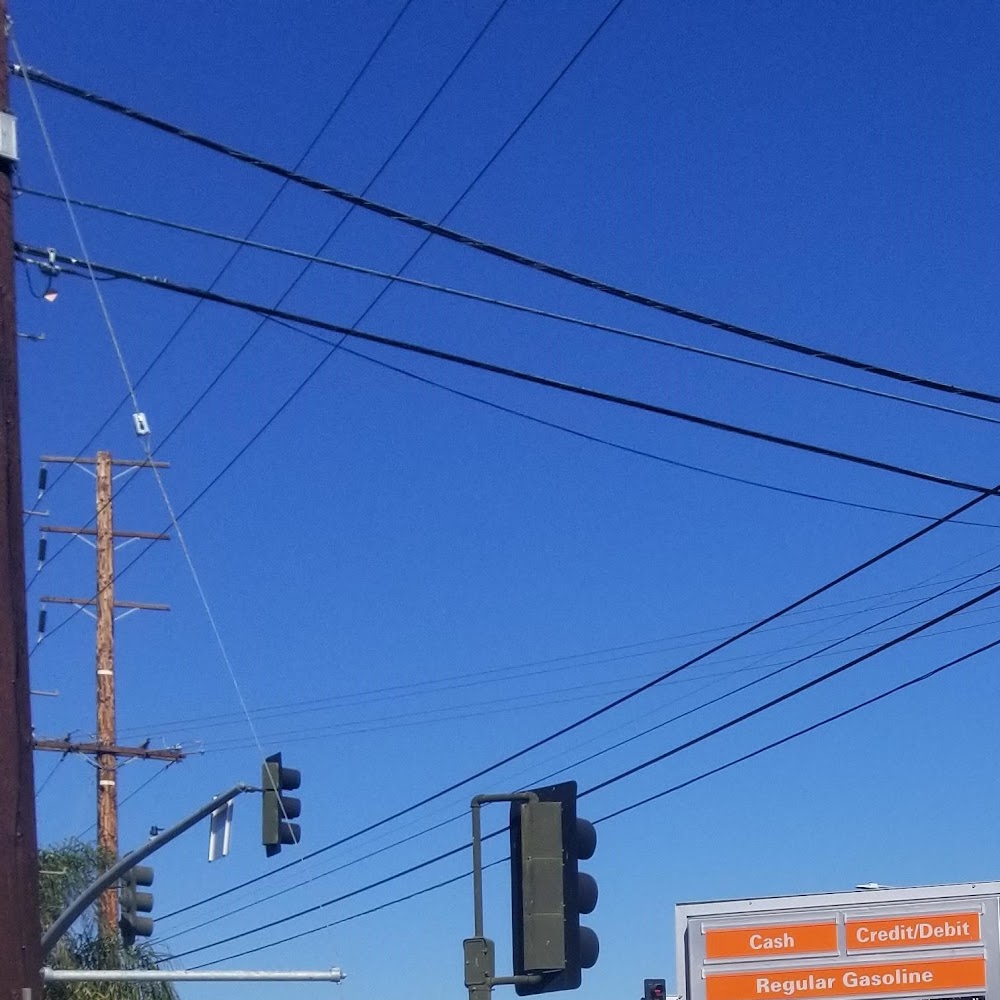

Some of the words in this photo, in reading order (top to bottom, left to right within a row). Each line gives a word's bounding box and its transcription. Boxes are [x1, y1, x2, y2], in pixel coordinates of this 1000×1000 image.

[750, 932, 795, 950] Cash
[855, 920, 971, 944] Credit/Debit
[756, 976, 836, 995] Regular
[842, 968, 934, 988] Gasoline
